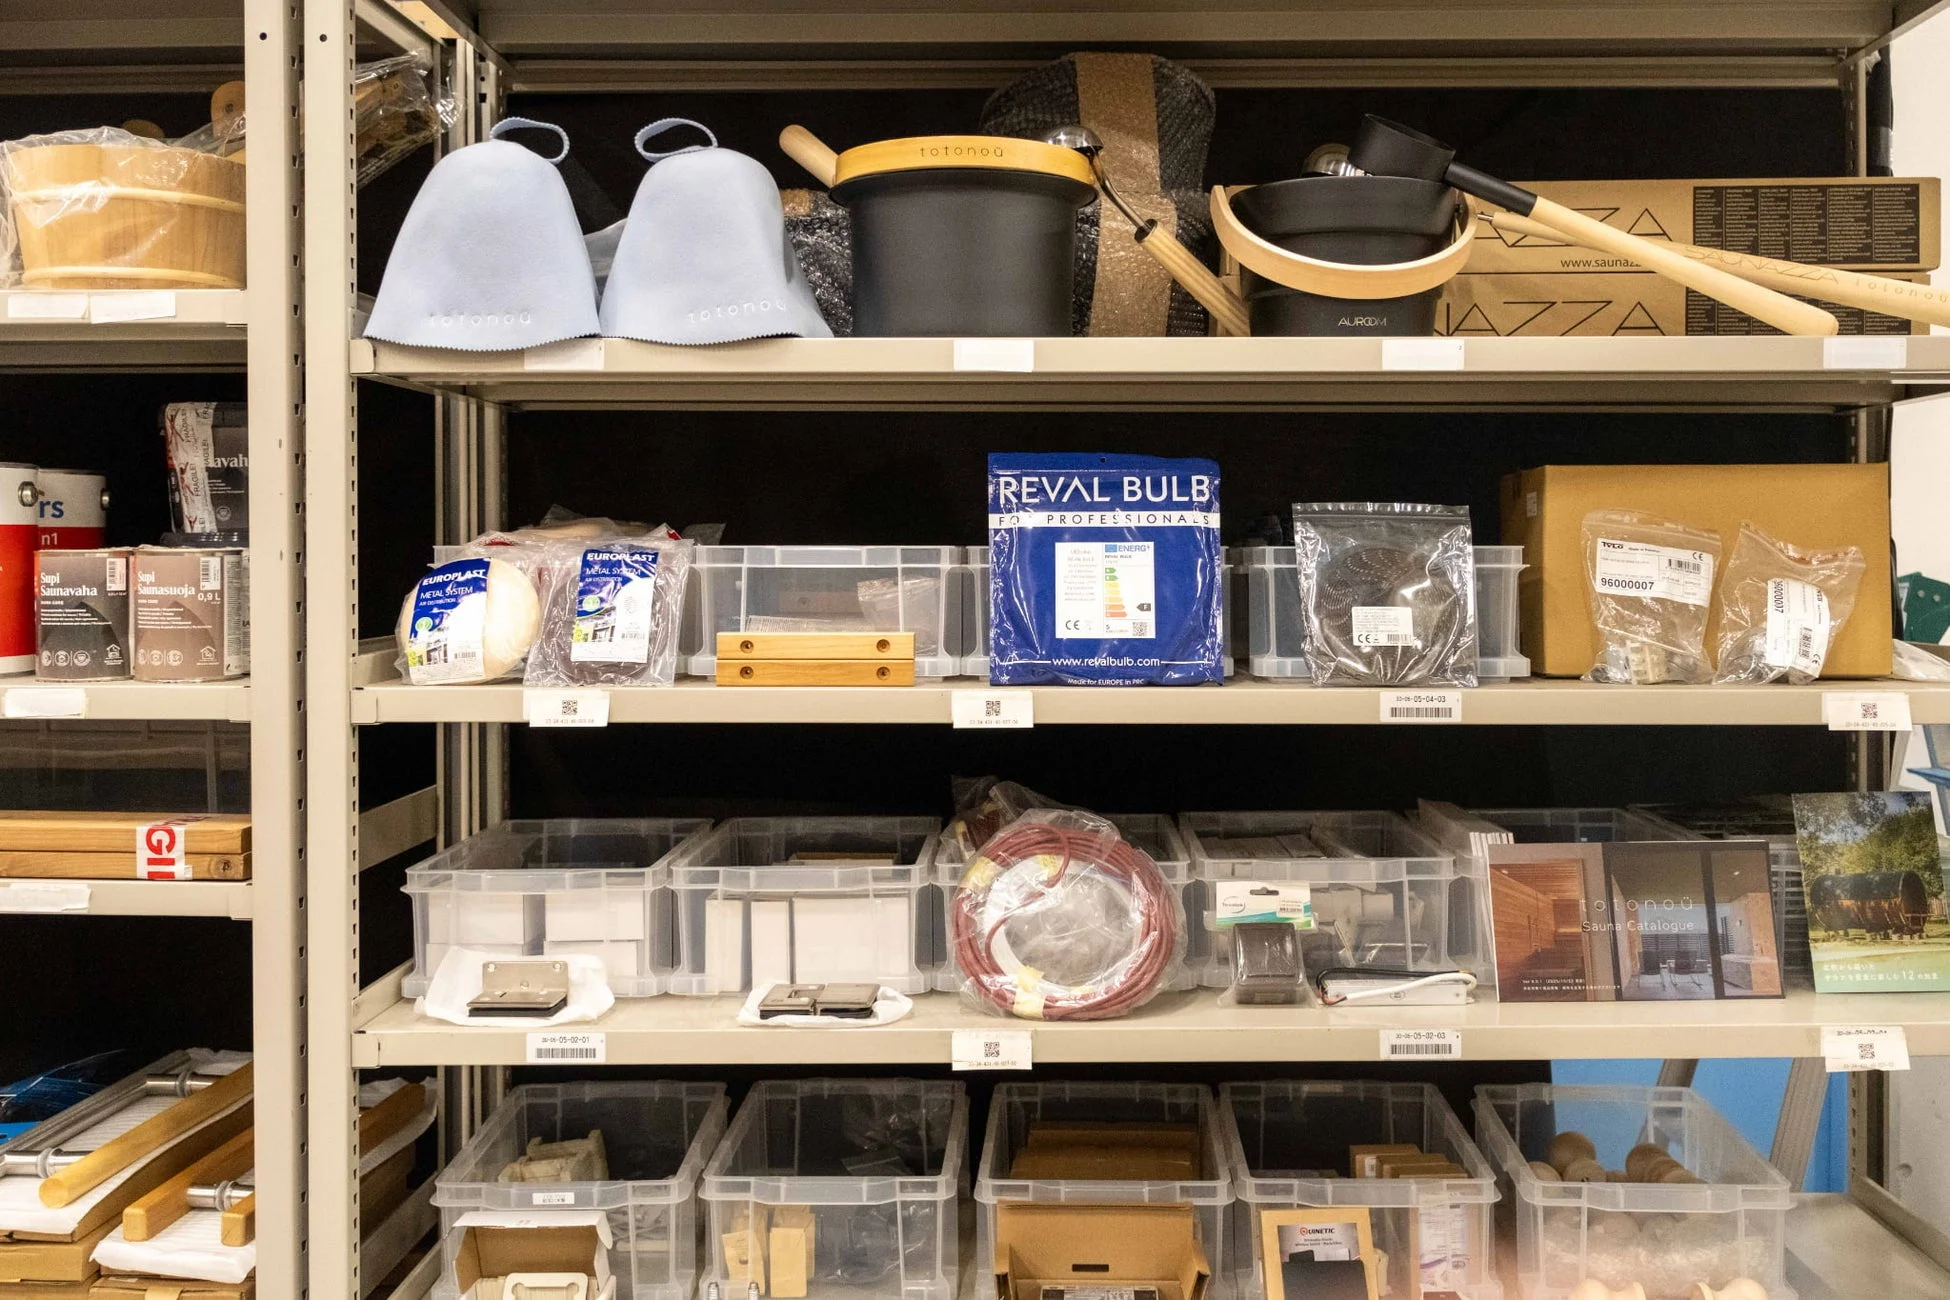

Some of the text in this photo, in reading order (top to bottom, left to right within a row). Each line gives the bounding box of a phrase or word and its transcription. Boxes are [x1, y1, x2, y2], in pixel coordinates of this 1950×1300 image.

[919, 145, 1004, 158] totonoü
[1337, 315, 1388, 327] AUROOM
[999, 474, 1210, 504] REVAL BULB
[1118, 544, 1147, 552] ENERG
[586, 552, 655, 562] EUROPLAST
[40, 572, 60, 586] Supi
[137, 570, 156, 584] Supi
[422, 569, 486, 586] EUROPLAST
[40, 584, 98, 597] Saunavaha
[137, 583, 196, 598] Saunasuoja
[1600, 577, 1655, 591] 96000007
[197, 592, 213, 603] 0,9
[214, 593, 221, 601] L
[420, 586, 474, 599] METAL SYSTEM
[1052, 656, 1161, 667] www.revalbulb.com
[1579, 896, 1694, 913] totonoü
[1581, 919, 1695, 934] Sauna Catalogue
